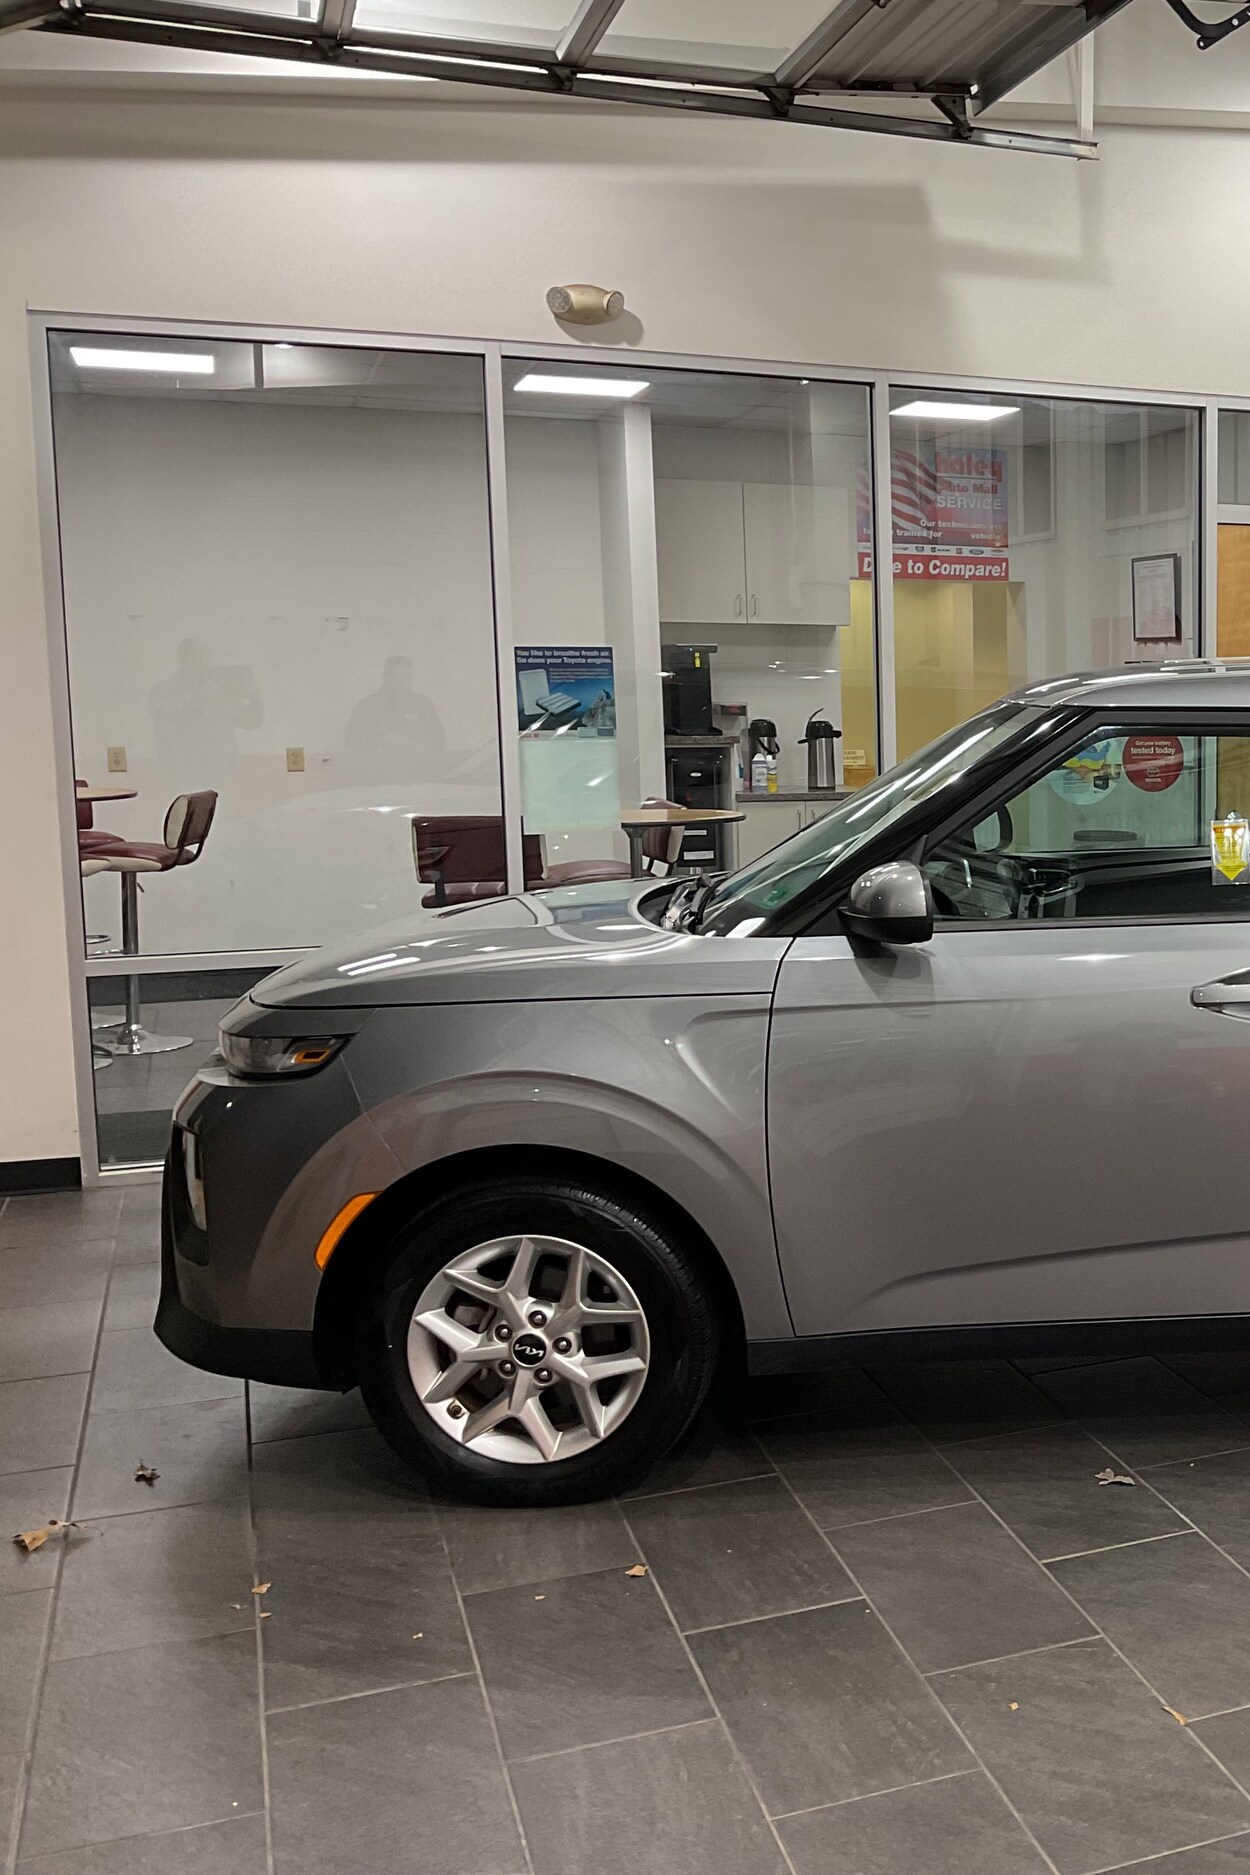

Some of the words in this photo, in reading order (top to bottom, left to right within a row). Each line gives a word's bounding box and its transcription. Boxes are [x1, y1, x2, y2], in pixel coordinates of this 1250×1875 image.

[936, 451, 1003, 483] haley
[939, 482, 969, 494] Auto
[972, 483, 998, 495] Mall
[936, 495, 1002, 510] SERVICE
[919, 519, 935, 527] Our
[896, 528, 927, 537] trained
[928, 529, 942, 539] for
[907, 558, 924, 574] to
[928, 559, 1007, 579] Compare!
[1155, 747, 1176, 755] today
